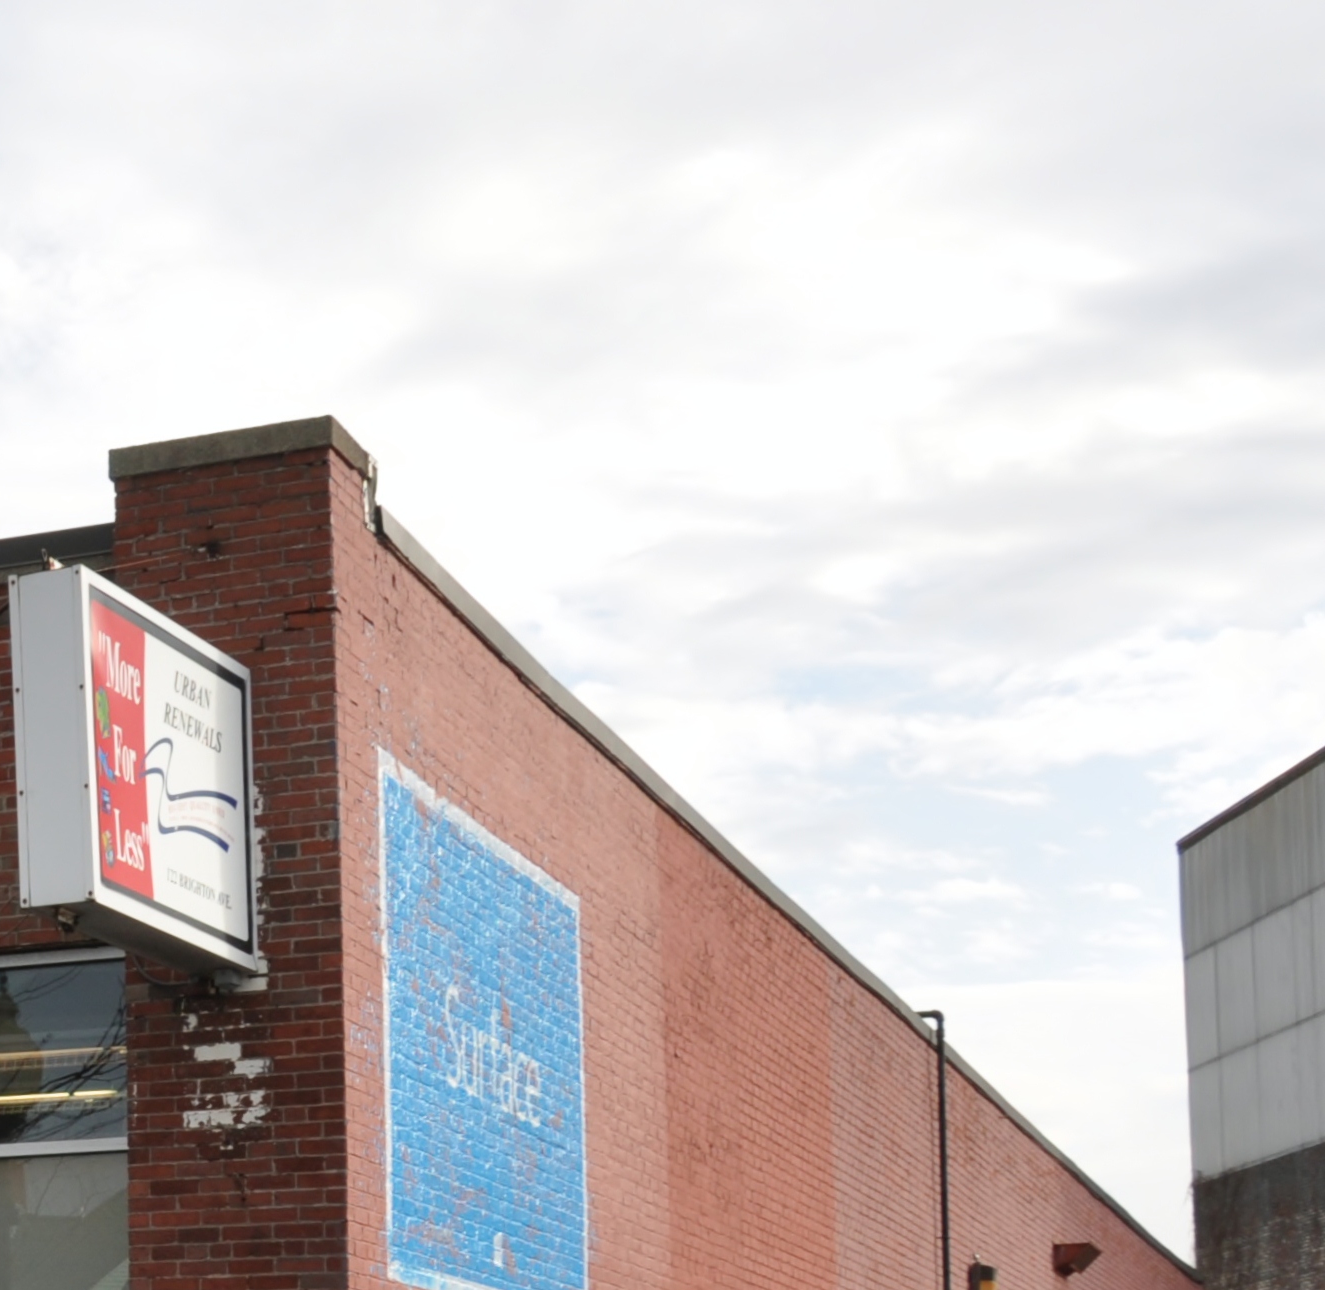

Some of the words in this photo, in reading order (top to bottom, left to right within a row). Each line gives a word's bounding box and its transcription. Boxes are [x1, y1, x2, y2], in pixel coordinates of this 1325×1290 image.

[173, 670, 212, 710] URBAN
[163, 702, 223, 754] RENEWALS
[112, 725, 137, 786] For
[178, 869, 216, 901] BRIGHTON
[446, 984, 542, 1128] Surface
